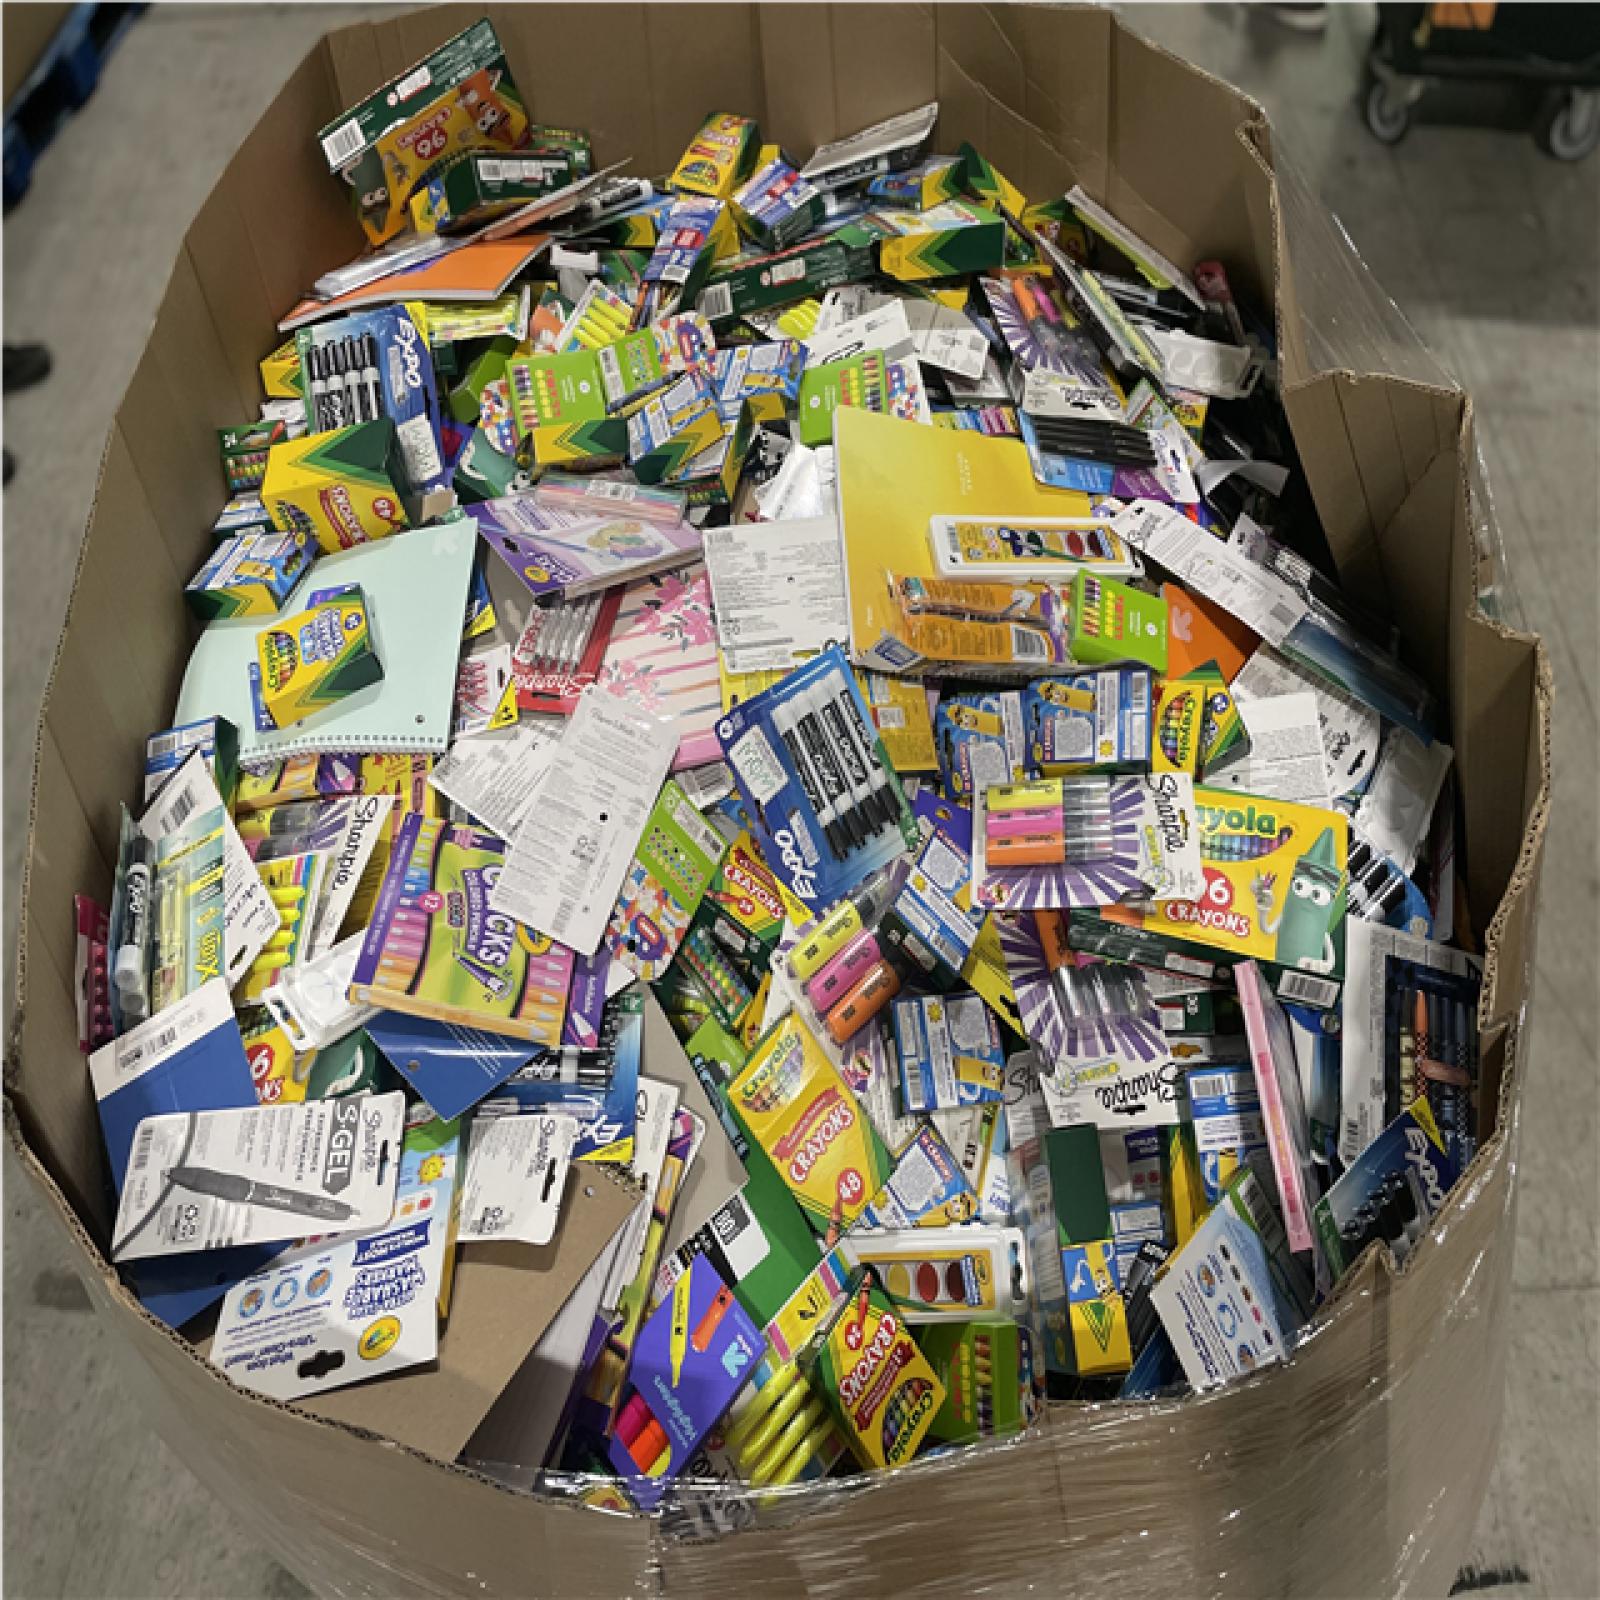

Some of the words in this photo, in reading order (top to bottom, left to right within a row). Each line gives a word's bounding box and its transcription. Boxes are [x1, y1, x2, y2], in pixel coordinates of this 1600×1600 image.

[1178, 698, 1196, 762] Crayola
[332, 797, 379, 890] Sharpie
[1148, 773, 1187, 853] Sharpie
[1200, 804, 1277, 837] yola
[480, 865, 516, 967] CCKS
[1164, 900, 1251, 937] CRAYONS
[1095, 1062, 1187, 1107] Sharpie
[788, 1101, 855, 1184] CRAYONS
[839, 1172, 862, 1197] 48
[838, 1312, 897, 1407] CRAYONS
